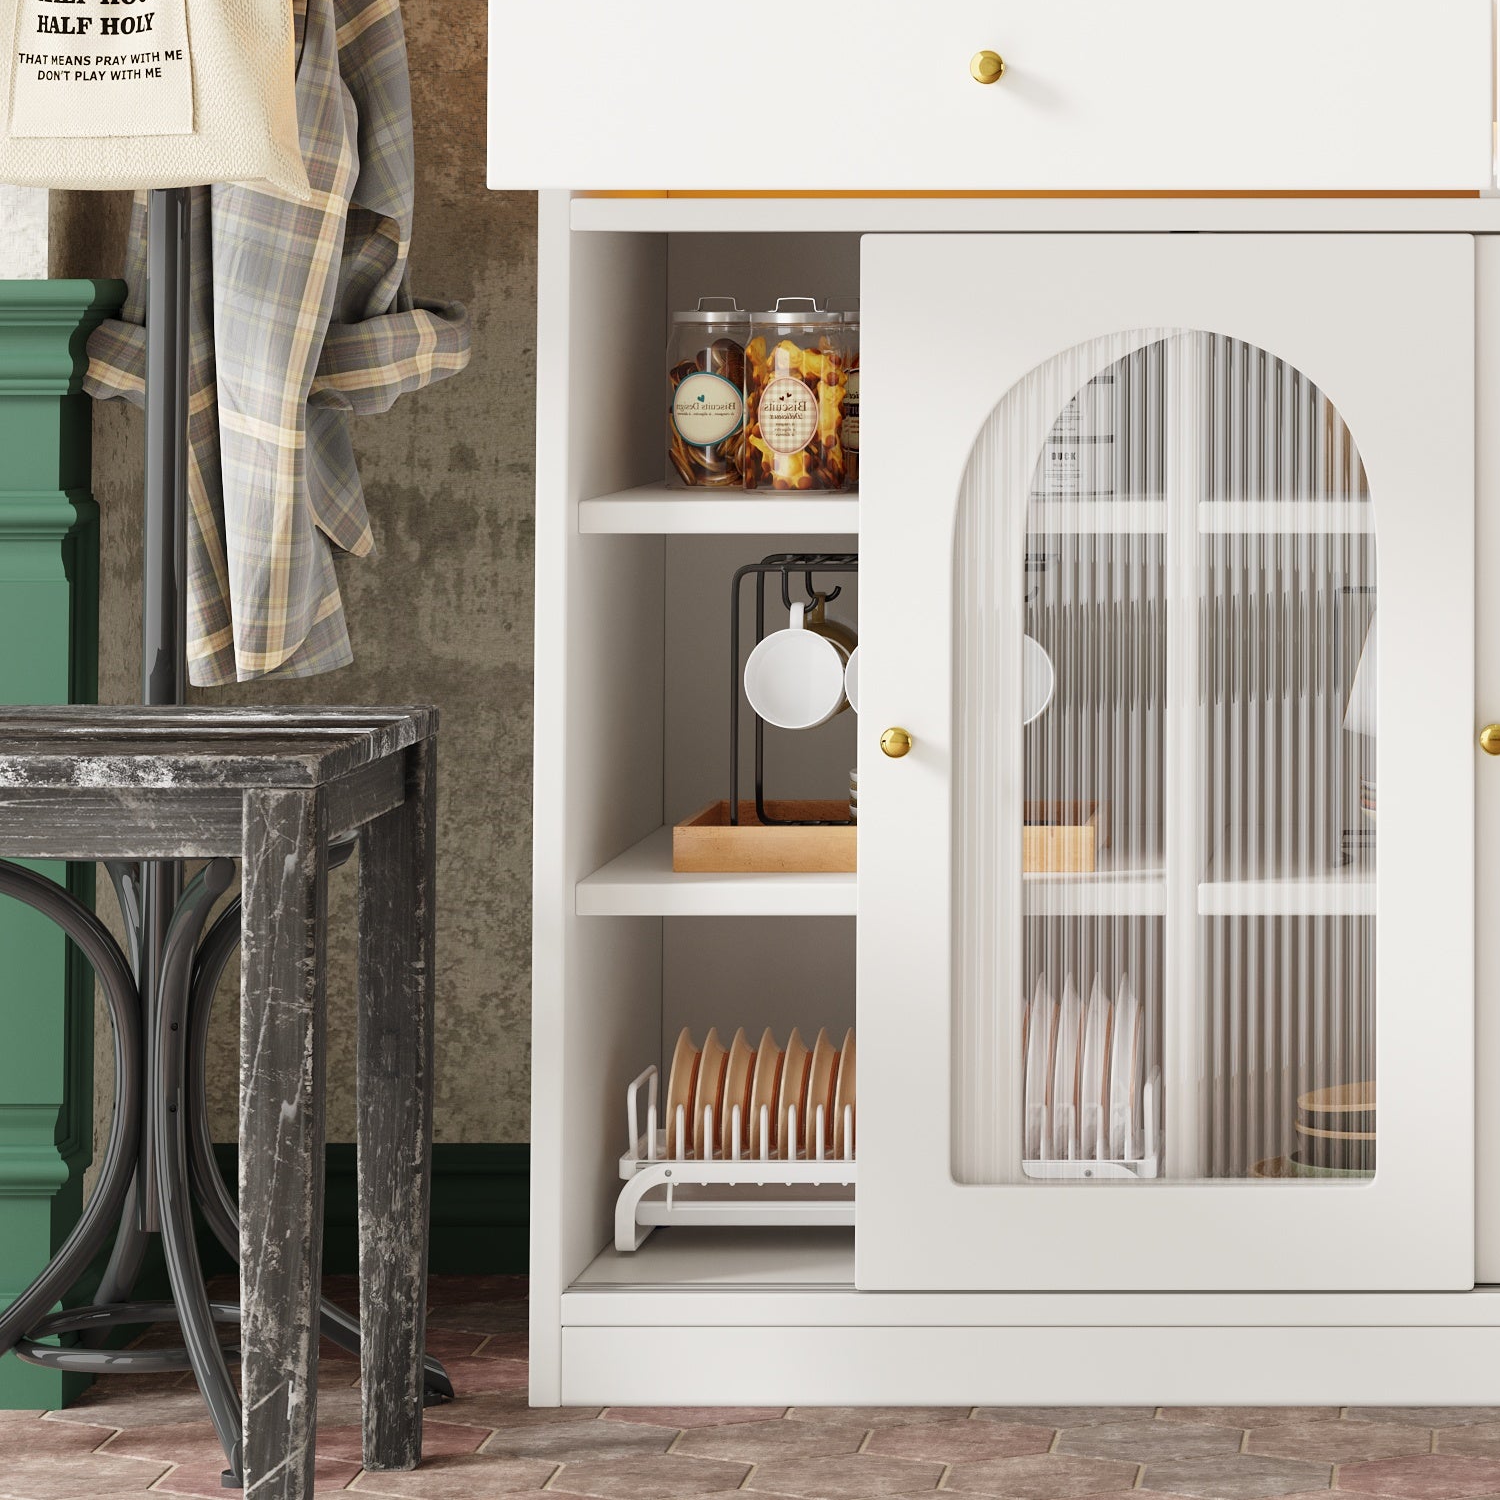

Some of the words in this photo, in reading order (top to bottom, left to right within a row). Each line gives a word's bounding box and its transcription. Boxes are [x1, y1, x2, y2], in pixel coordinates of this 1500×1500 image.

[37, 14, 92, 35] HALF
[100, 12, 155, 35] HOLY
[18, 52, 48, 65] THAT
[51, 55, 91, 66] MEANS
[95, 55, 127, 66] PRAY
[131, 52, 160, 64] WITH
[165, 49, 183, 62] ME
[37, 70, 70, 81] DON'T
[75, 71, 106, 81] PLAY
[110, 69, 141, 81] WITH
[145, 67, 162, 78] ME
